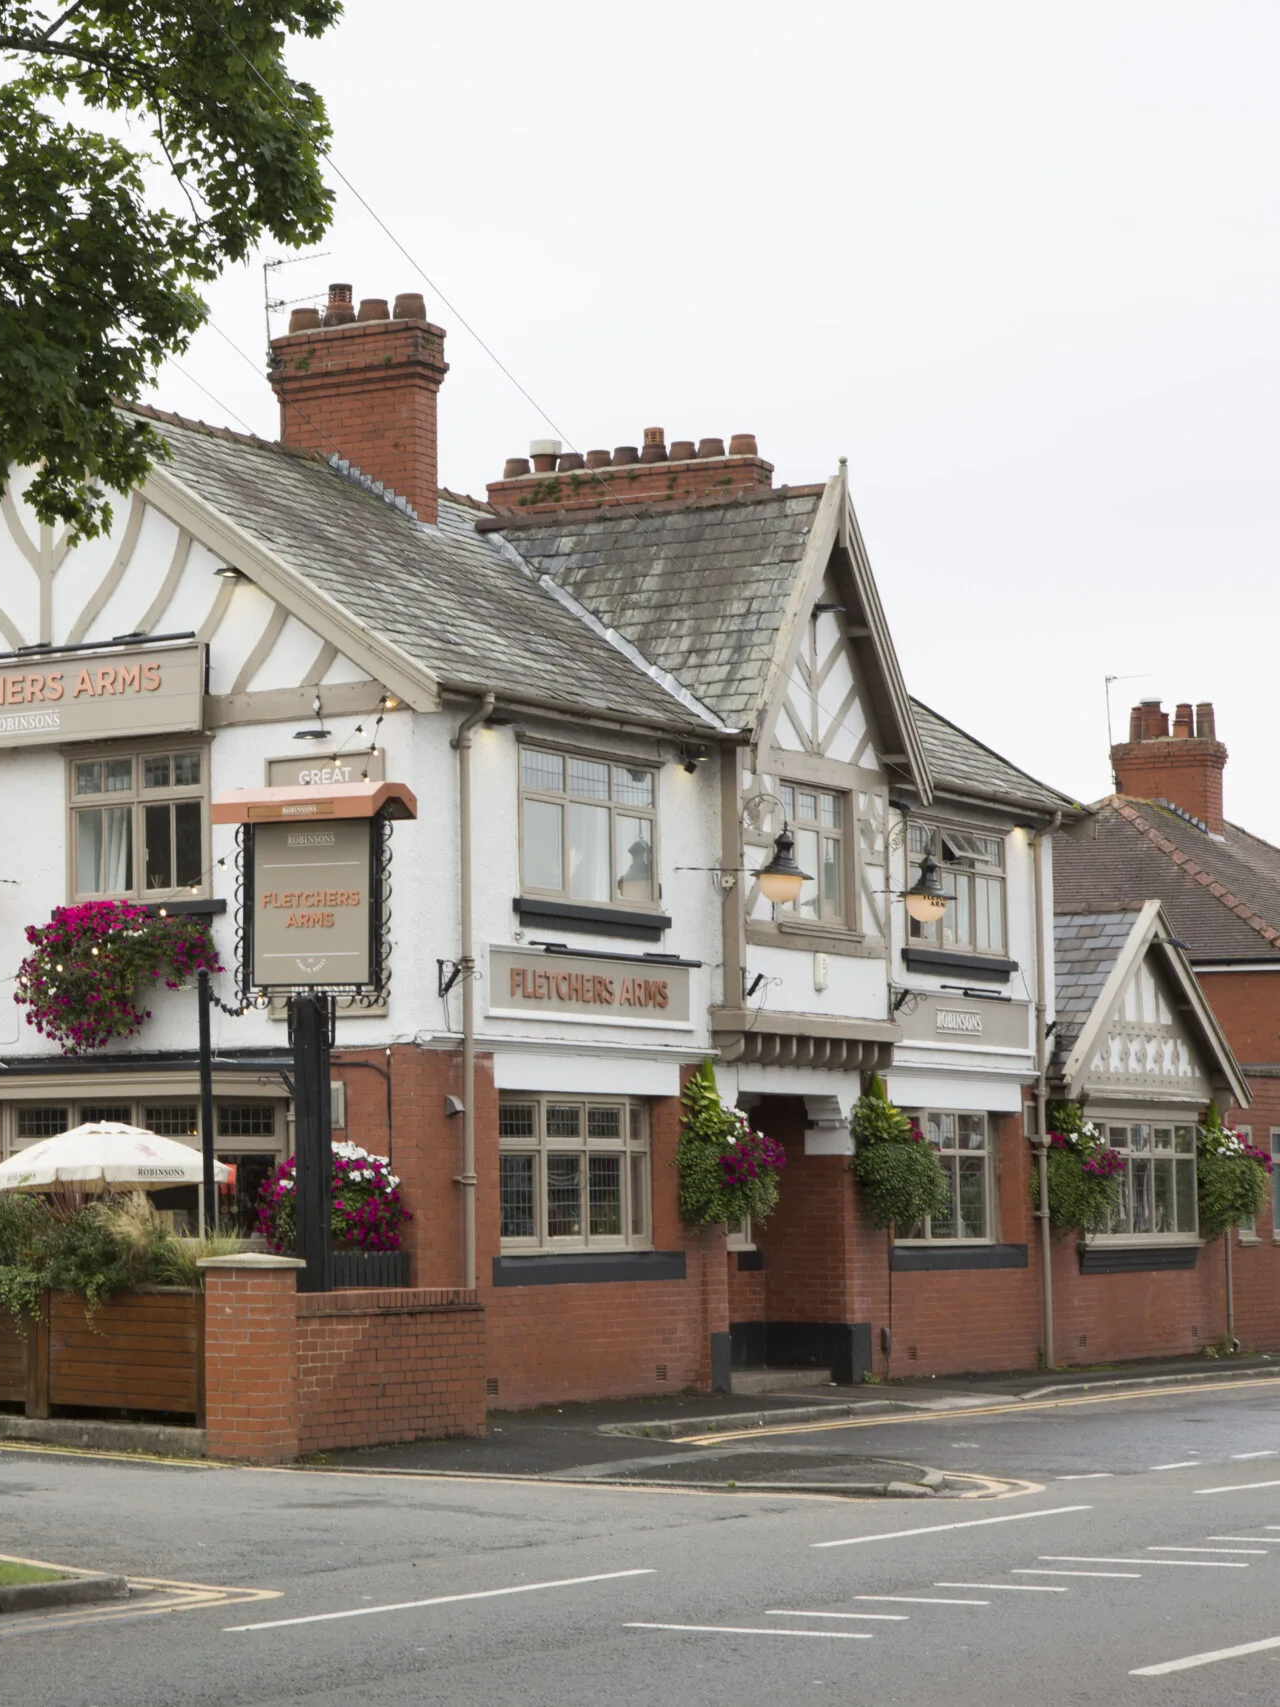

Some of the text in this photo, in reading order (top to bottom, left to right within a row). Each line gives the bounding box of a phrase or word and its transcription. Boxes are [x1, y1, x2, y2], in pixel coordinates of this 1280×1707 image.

[73, 662, 162, 698] ARMS
[299, 767, 352, 785] GREAT
[282, 805, 317, 815] ROBINSONS
[287, 833, 336, 845] ROBINSONS
[262, 889, 360, 909] FLETCHERS
[286, 911, 335, 928] ARMS
[510, 967, 669, 1008] FLETCHERS ARMS
[936, 1011, 982, 1031] ROBINSONS
[138, 1168, 185, 1176] ROBINSONS
